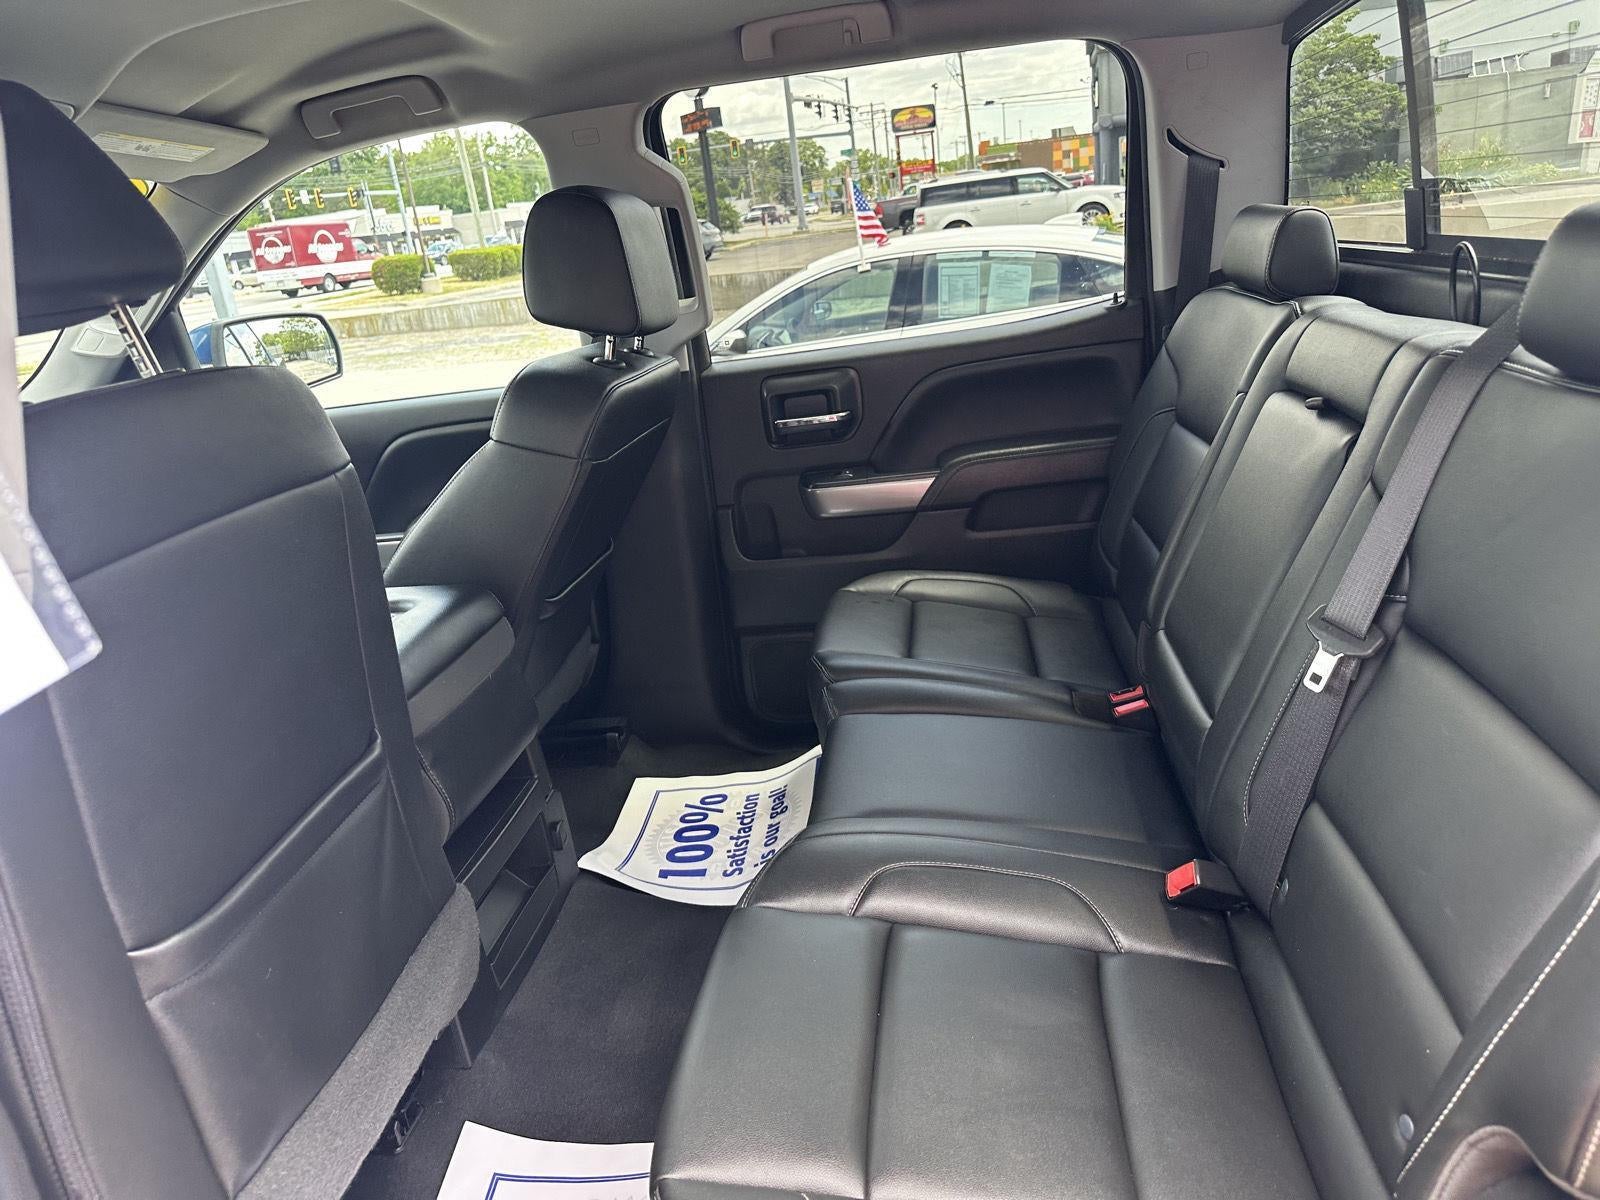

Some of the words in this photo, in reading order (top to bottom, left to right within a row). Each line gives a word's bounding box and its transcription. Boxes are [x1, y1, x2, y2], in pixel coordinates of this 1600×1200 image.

[768, 784, 789, 819] goal!
[658, 793, 728, 879] 100%
[722, 792, 760, 878] Satisfaction
[763, 820, 781, 847] our
[753, 849, 776, 867] is
